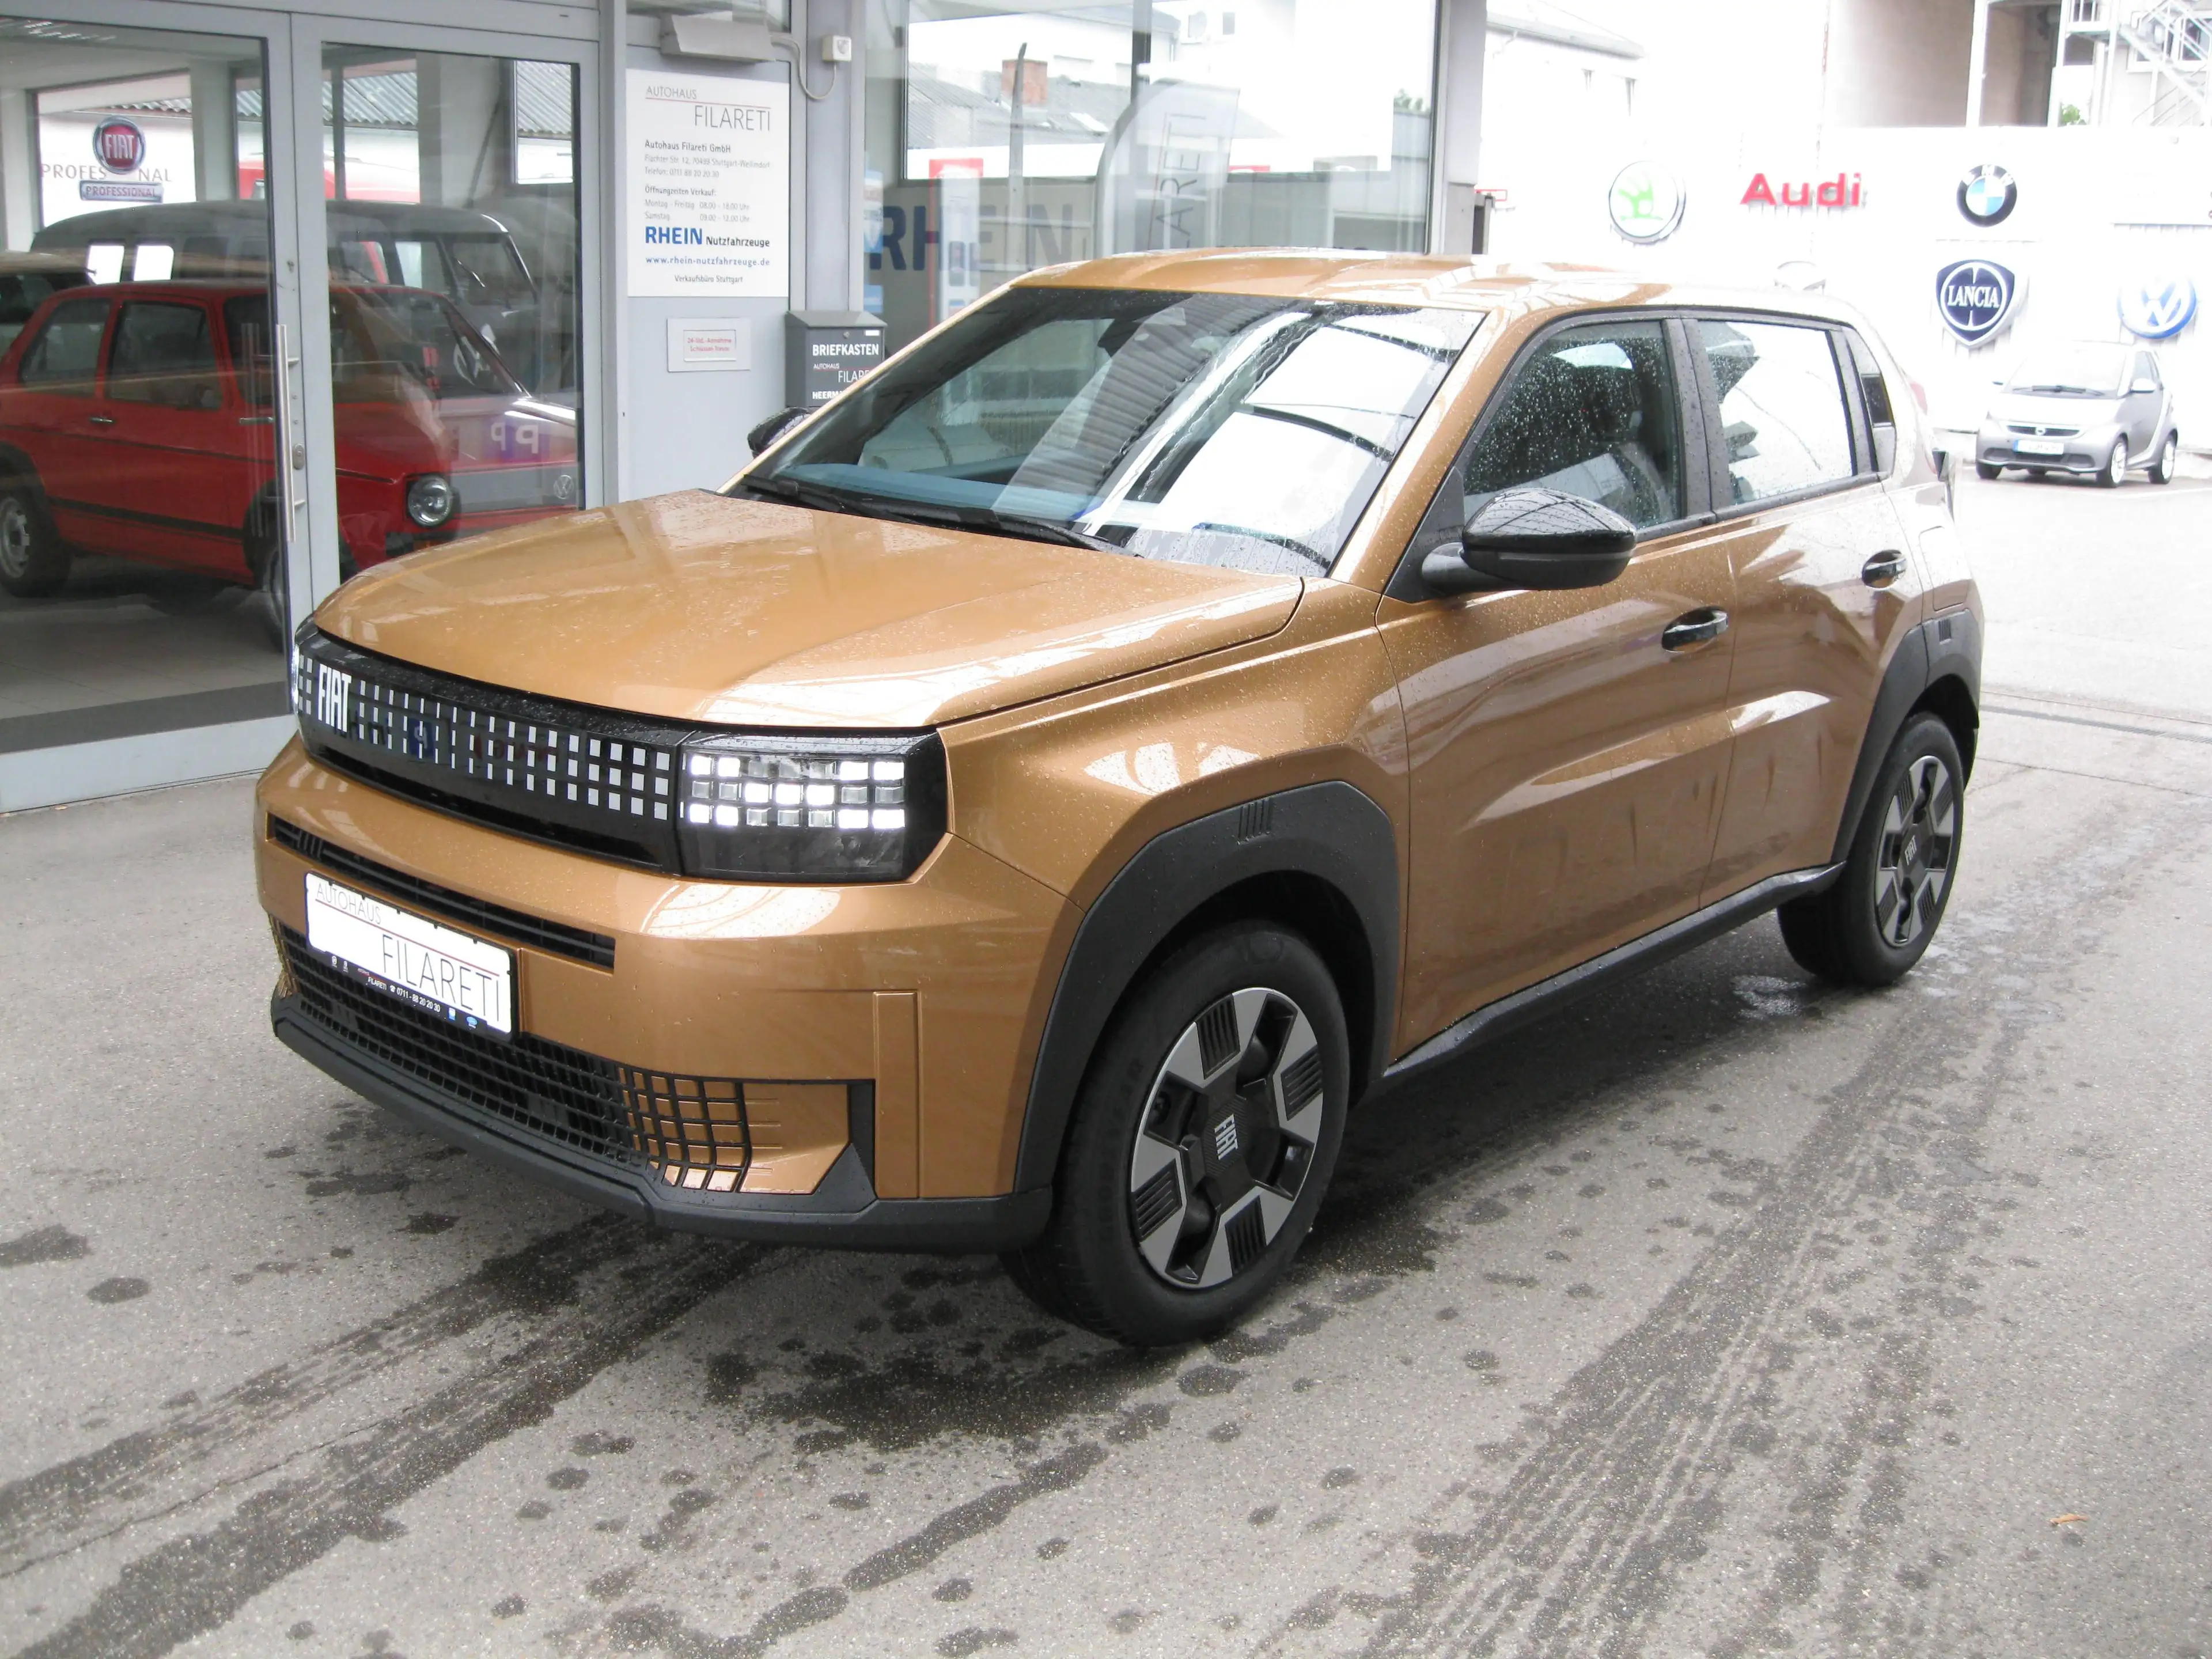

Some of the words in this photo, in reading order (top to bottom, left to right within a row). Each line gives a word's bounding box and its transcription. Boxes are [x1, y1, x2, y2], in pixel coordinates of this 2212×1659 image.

[646, 86, 697, 100] AUTOHAUS
[695, 105, 771, 131] FILARETI
[104, 134, 134, 159] FIAT
[645, 139, 680, 150] Autohaus
[682, 142, 707, 152] Filareti
[710, 144, 731, 153] GmbH
[86, 185, 157, 197] PROFESSIONAL
[1156, 113, 1206, 249] ARETI
[1740, 172, 1862, 207] Audi
[645, 199, 668, 209] Montag
[645, 211, 671, 222] Samstag
[645, 225, 702, 244] RHEIN
[706, 236, 770, 248] Nutzfahrzeuge
[870, 206, 1074, 271] RHEN
[646, 256, 770, 268] www.rhein-nutzfahrzeuge.de
[675, 274, 714, 283] Verkaufsbüro
[716, 275, 743, 285] Stuttgart
[1947, 285, 1999, 308] LANCIA
[812, 344, 879, 356] BRIEFKASTEN
[838, 370, 870, 383] FILAR
[812, 391, 842, 399] HEERM
[317, 663, 352, 733] FIAT
[1904, 835, 1917, 866] FIAT
[317, 882, 381, 925] AUTOHAUS
[382, 934, 499, 1022] FILARETI
[368, 976, 387, 991] FILARETI
[397, 987, 409, 999] 0711
[419, 996, 427, 1006] 20
[427, 999, 434, 1009] 20
[434, 1001, 441, 1013] 30
[1214, 1113, 1238, 1161] FIAT
